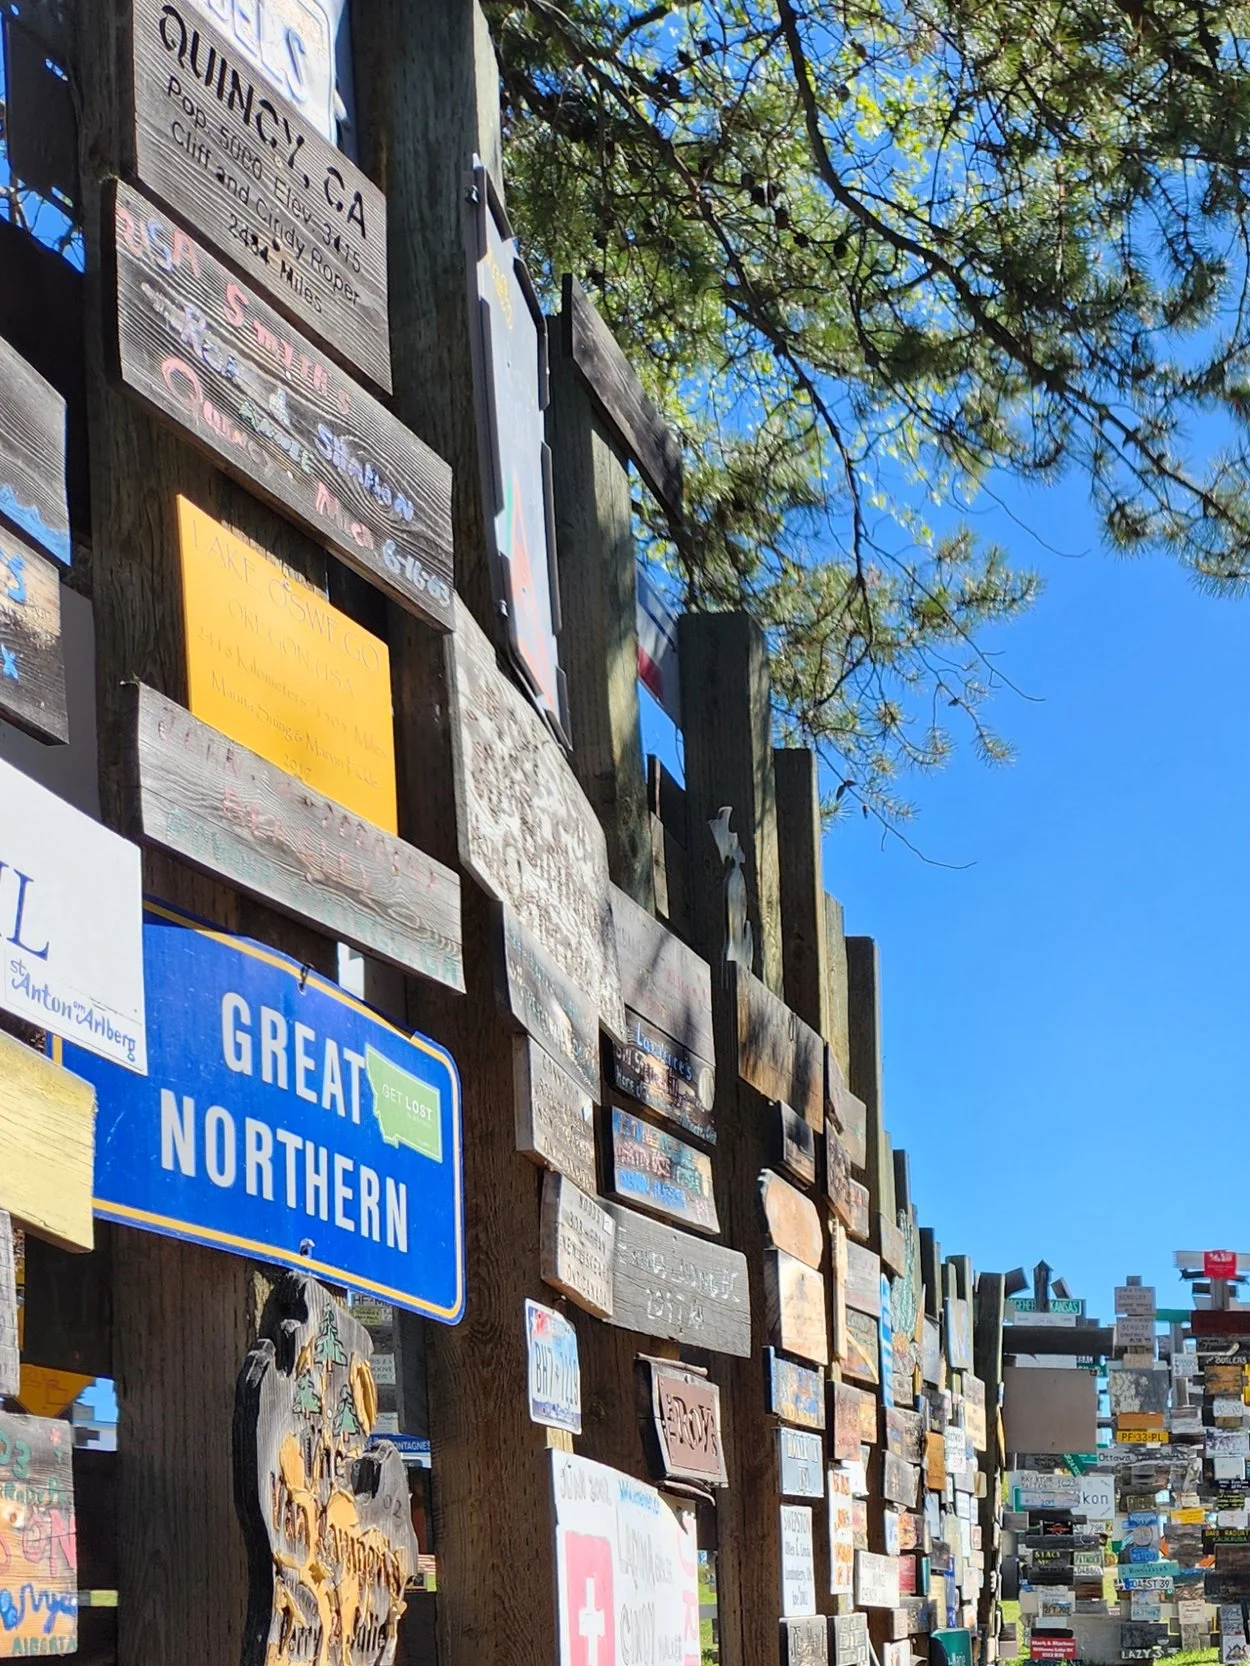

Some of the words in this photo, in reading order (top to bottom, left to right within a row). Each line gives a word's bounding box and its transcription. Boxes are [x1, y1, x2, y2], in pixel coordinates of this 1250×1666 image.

[158, 6, 311, 190] QUINCY,
[324, 165, 367, 240] CA
[167, 76, 208, 134] Pop.
[275, 178, 316, 235] Elev.
[171, 121, 212, 174] Cliff
[216, 159, 252, 212] and
[311, 248, 361, 306] Roper
[280, 260, 323, 314] Miles
[191, 518, 261, 597] LAKE
[267, 578, 380, 671] OSWEGO
[11, 970, 75, 1022] Anton
[77, 1008, 137, 1062] Arlberg
[220, 990, 366, 1126] GREAT
[160, 1087, 408, 1254] NORTHERN
[382, 1083, 404, 1106] GET
[405, 1086, 433, 1121] LOST
[1121, 1649, 1147, 1660] LAZY
